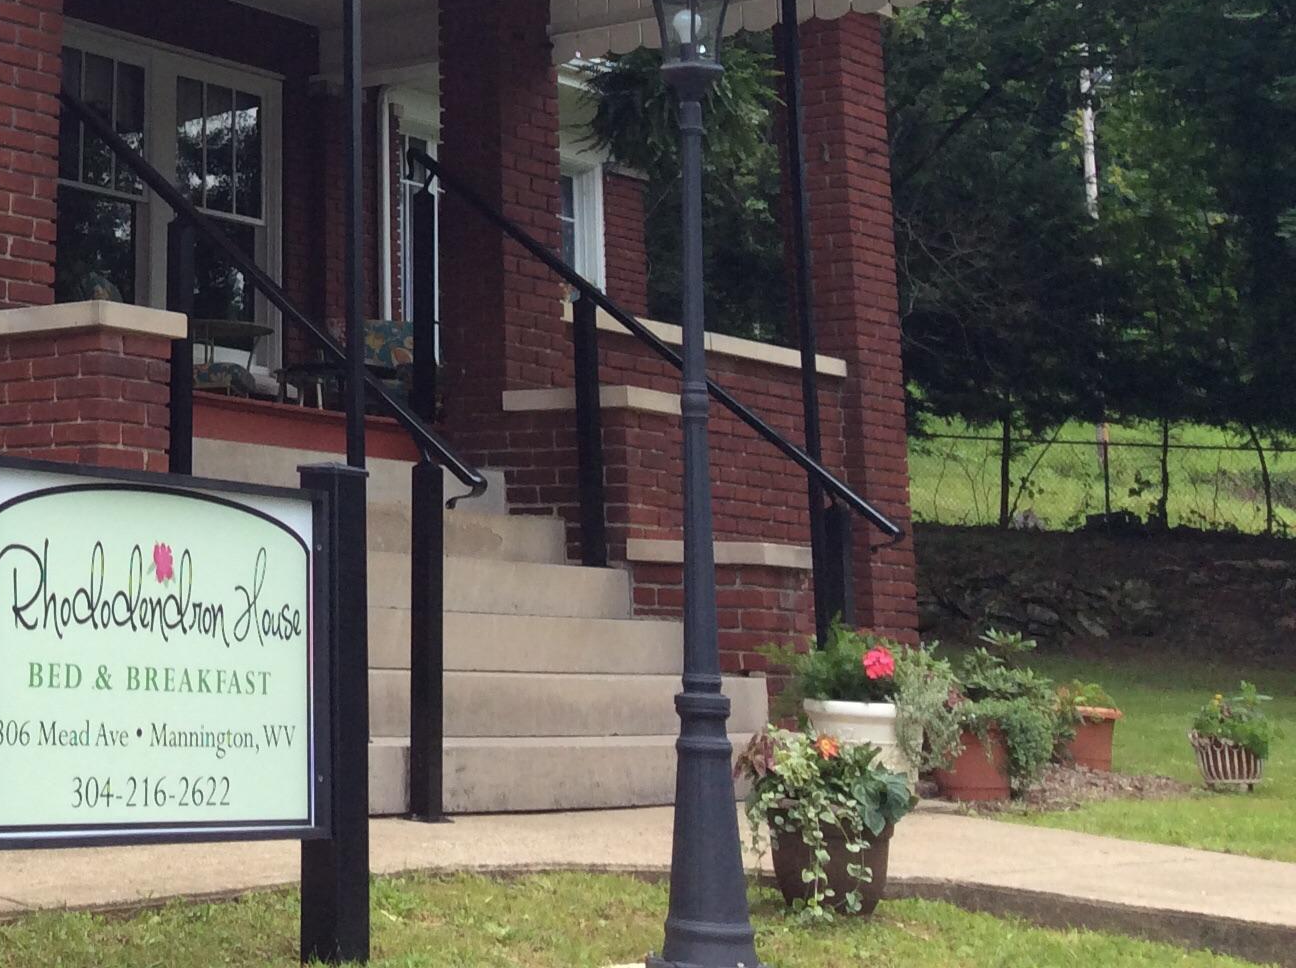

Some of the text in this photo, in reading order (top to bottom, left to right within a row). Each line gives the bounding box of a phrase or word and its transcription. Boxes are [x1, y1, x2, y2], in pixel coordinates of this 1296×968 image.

[233, 547, 302, 647] House
[28, 662, 272, 696] BED & BREAKFAST
[37, 720, 90, 747] Mead
[95, 722, 130, 747] Ave
[149, 722, 260, 759] Mannington,
[262, 724, 297, 748] WV
[70, 775, 231, 808] 304-216-2622
